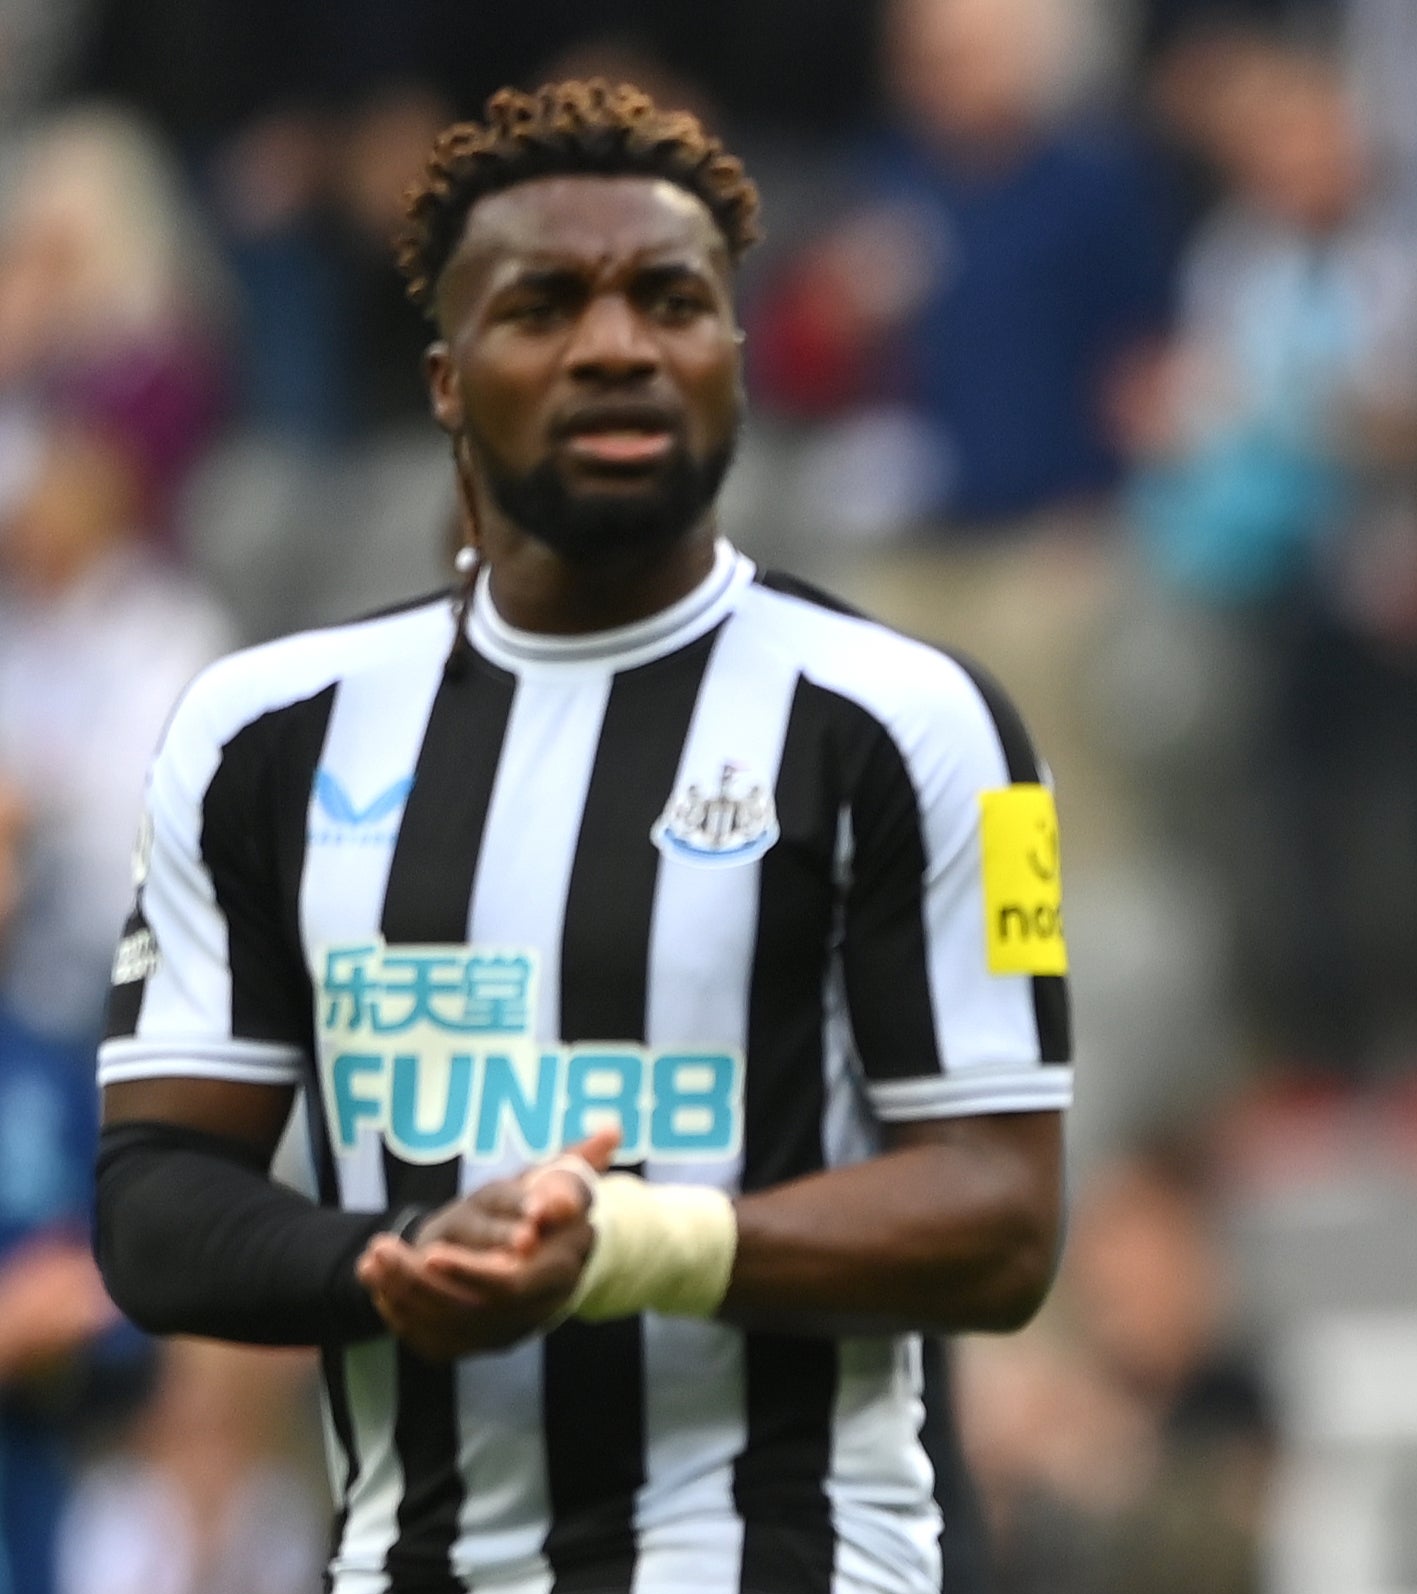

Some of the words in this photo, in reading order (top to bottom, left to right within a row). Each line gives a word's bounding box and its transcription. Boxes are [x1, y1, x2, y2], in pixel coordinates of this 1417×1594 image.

[997, 903, 1064, 944] no
[324, 945, 532, 1035] 乐天堂
[332, 1052, 736, 1153] FUN88
